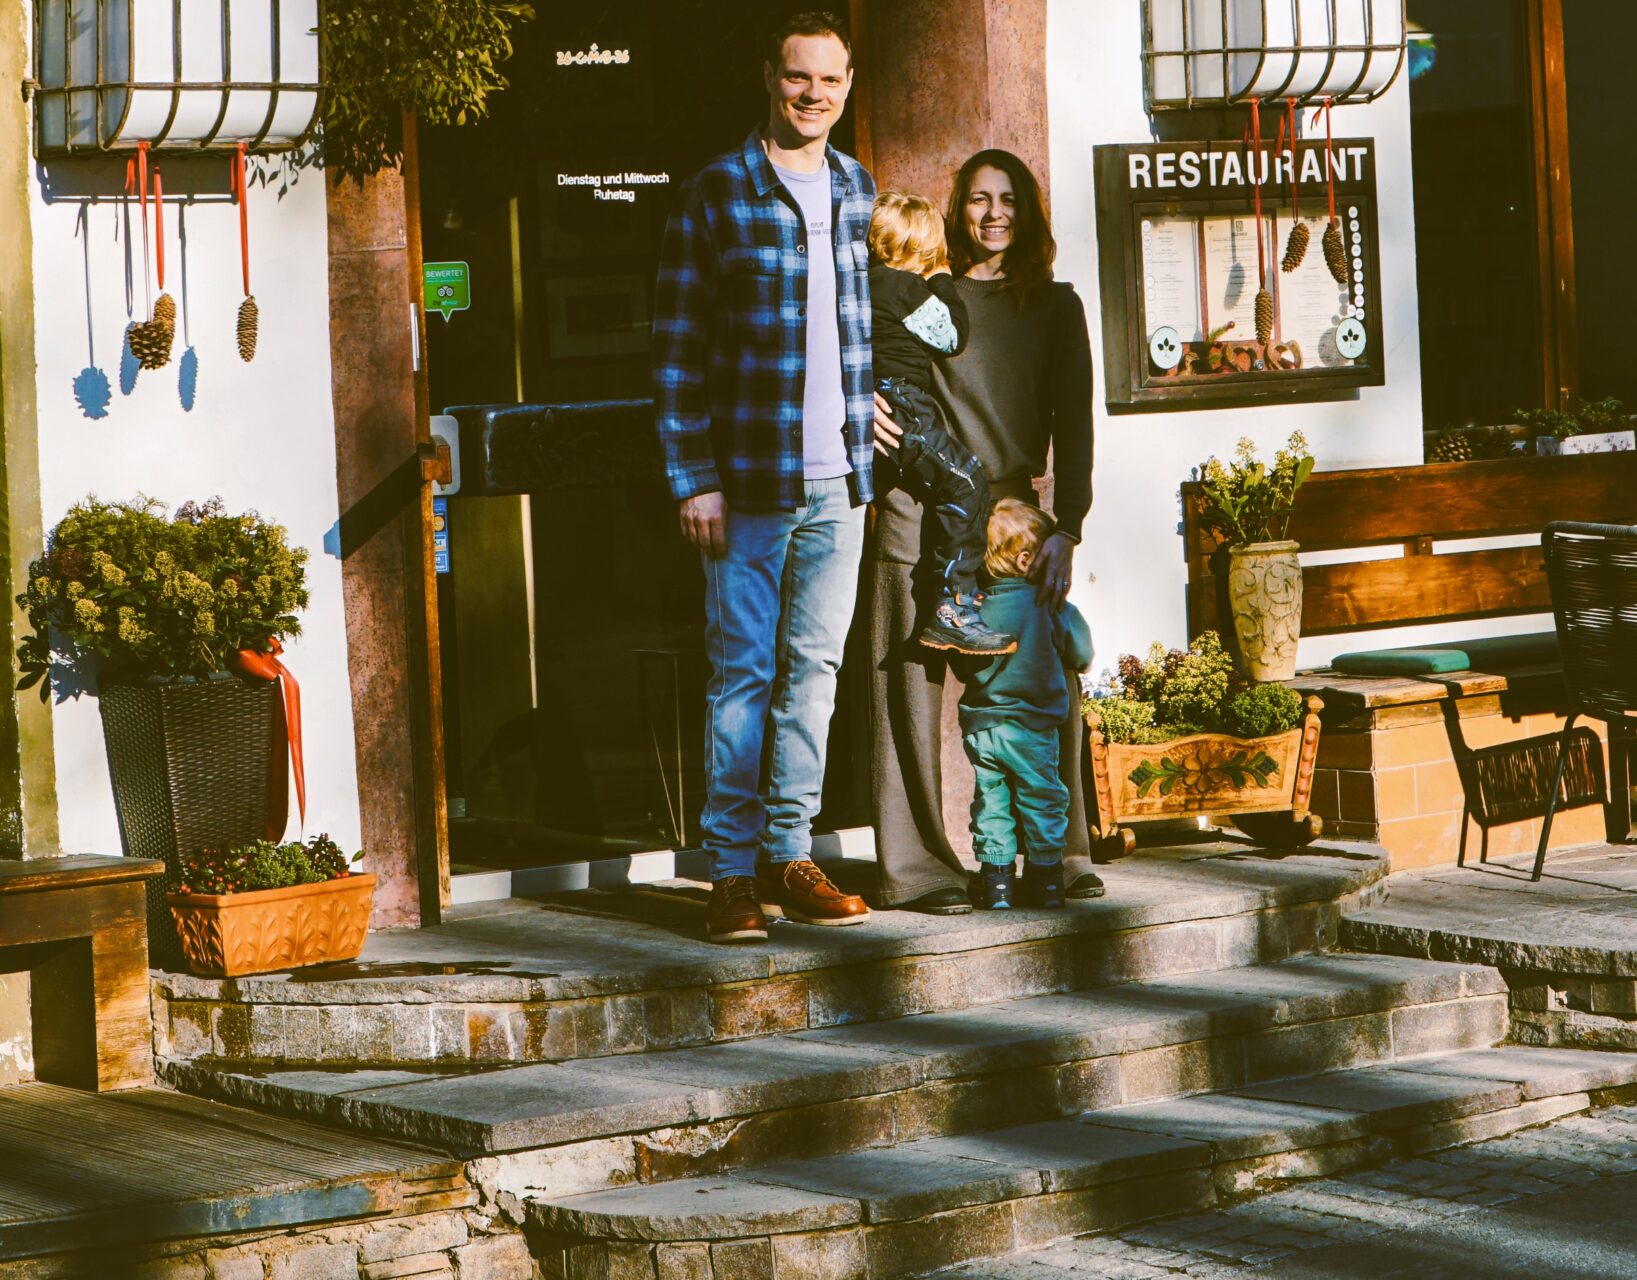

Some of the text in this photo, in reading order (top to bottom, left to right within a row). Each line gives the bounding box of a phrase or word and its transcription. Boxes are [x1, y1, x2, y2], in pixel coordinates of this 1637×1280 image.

[1128, 147, 1368, 189] RESTAURANT
[557, 172, 670, 187] Dienstag und Mittwoch
[593, 189, 635, 202] Ruhetag
[425, 269, 464, 278] BEWERTET
